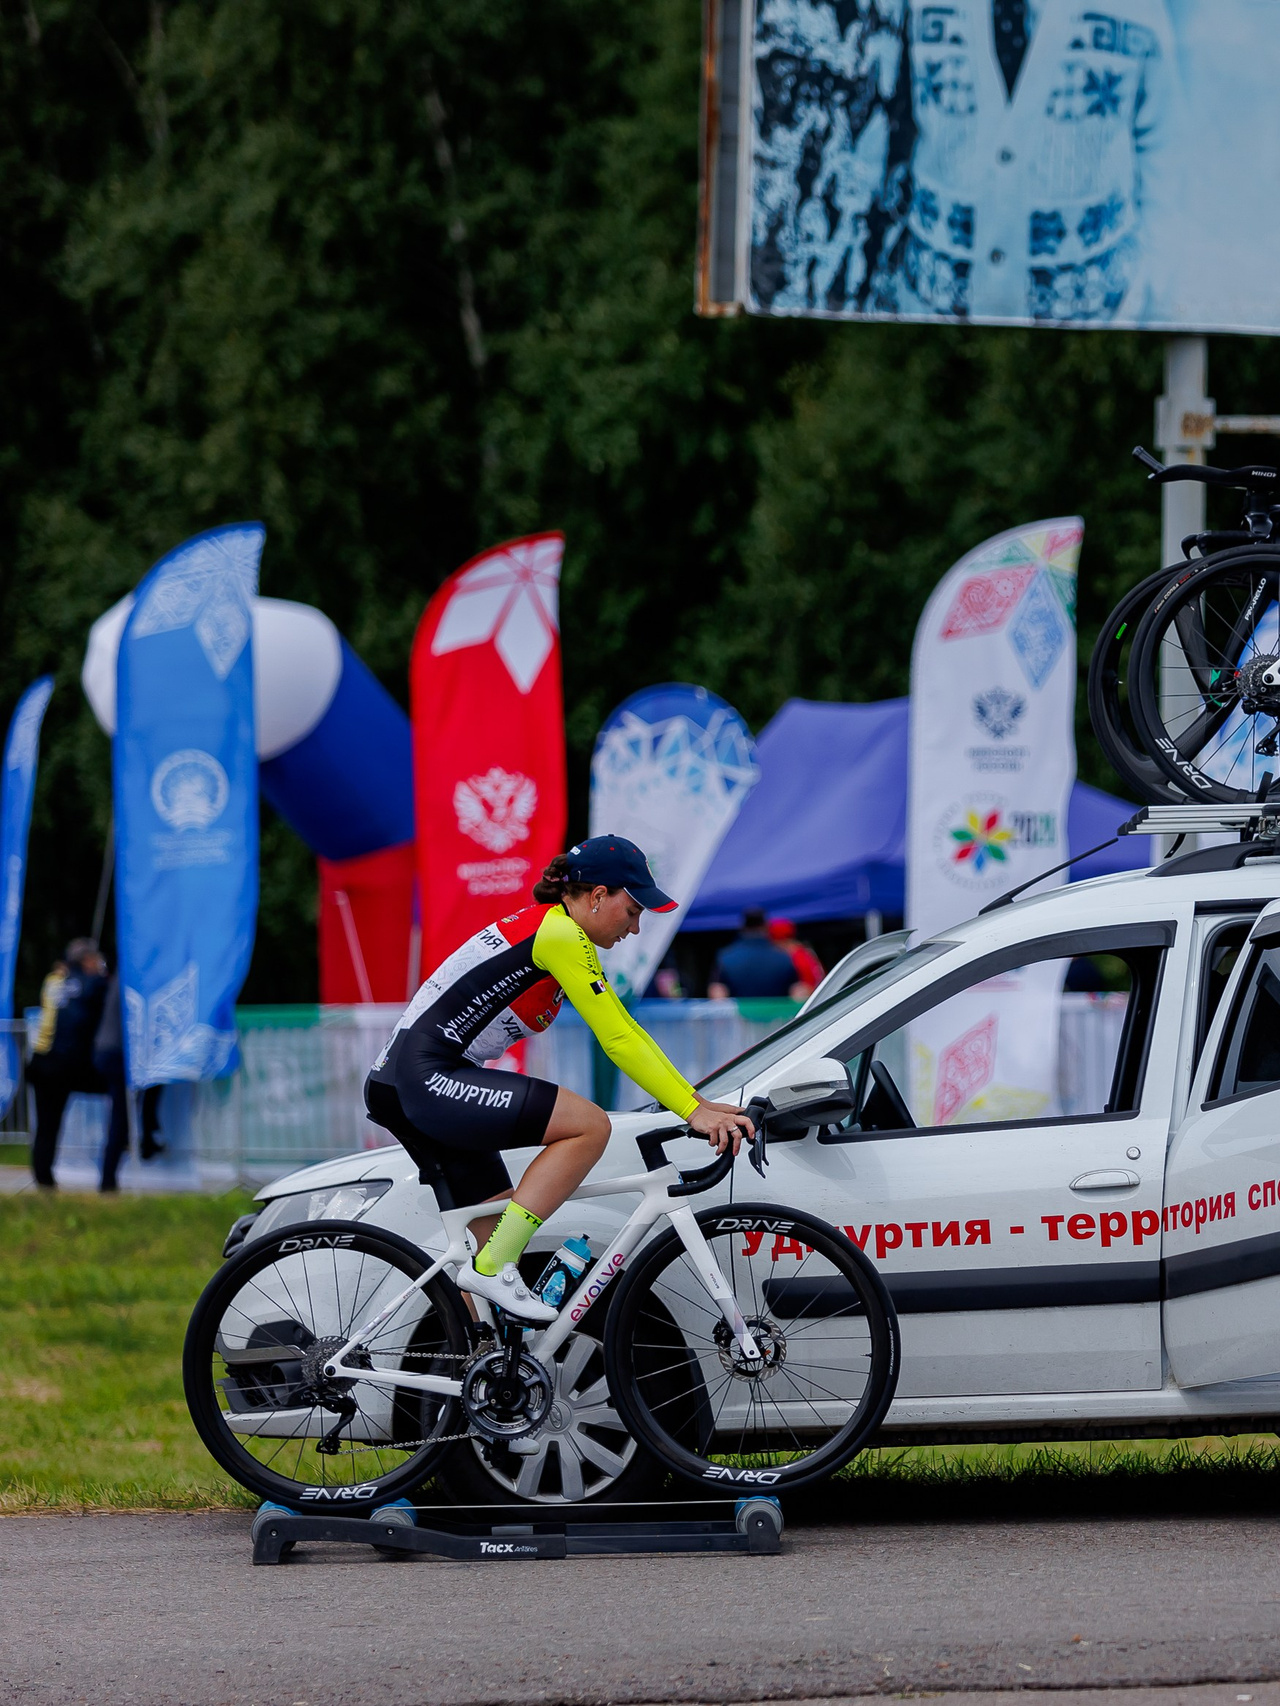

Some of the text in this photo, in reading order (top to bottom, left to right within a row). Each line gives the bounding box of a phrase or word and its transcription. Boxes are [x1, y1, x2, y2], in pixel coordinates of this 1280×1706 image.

[1155, 737, 1212, 790] DRIVE
[447, 1004, 476, 1030] VILLA
[472, 966, 533, 1006] VALENTINA
[425, 1072, 513, 1109] УДМУРТИЯ
[716, 1218, 795, 1233] DRIVE
[278, 1235, 356, 1252] DRIVE
[741, 1219, 991, 1261] Удуртия
[570, 1253, 625, 1322] evolve
[702, 1466, 782, 1485] DRIVE
[299, 1486, 379, 1500] DRIVE
[480, 1542, 514, 1553] Tacx
